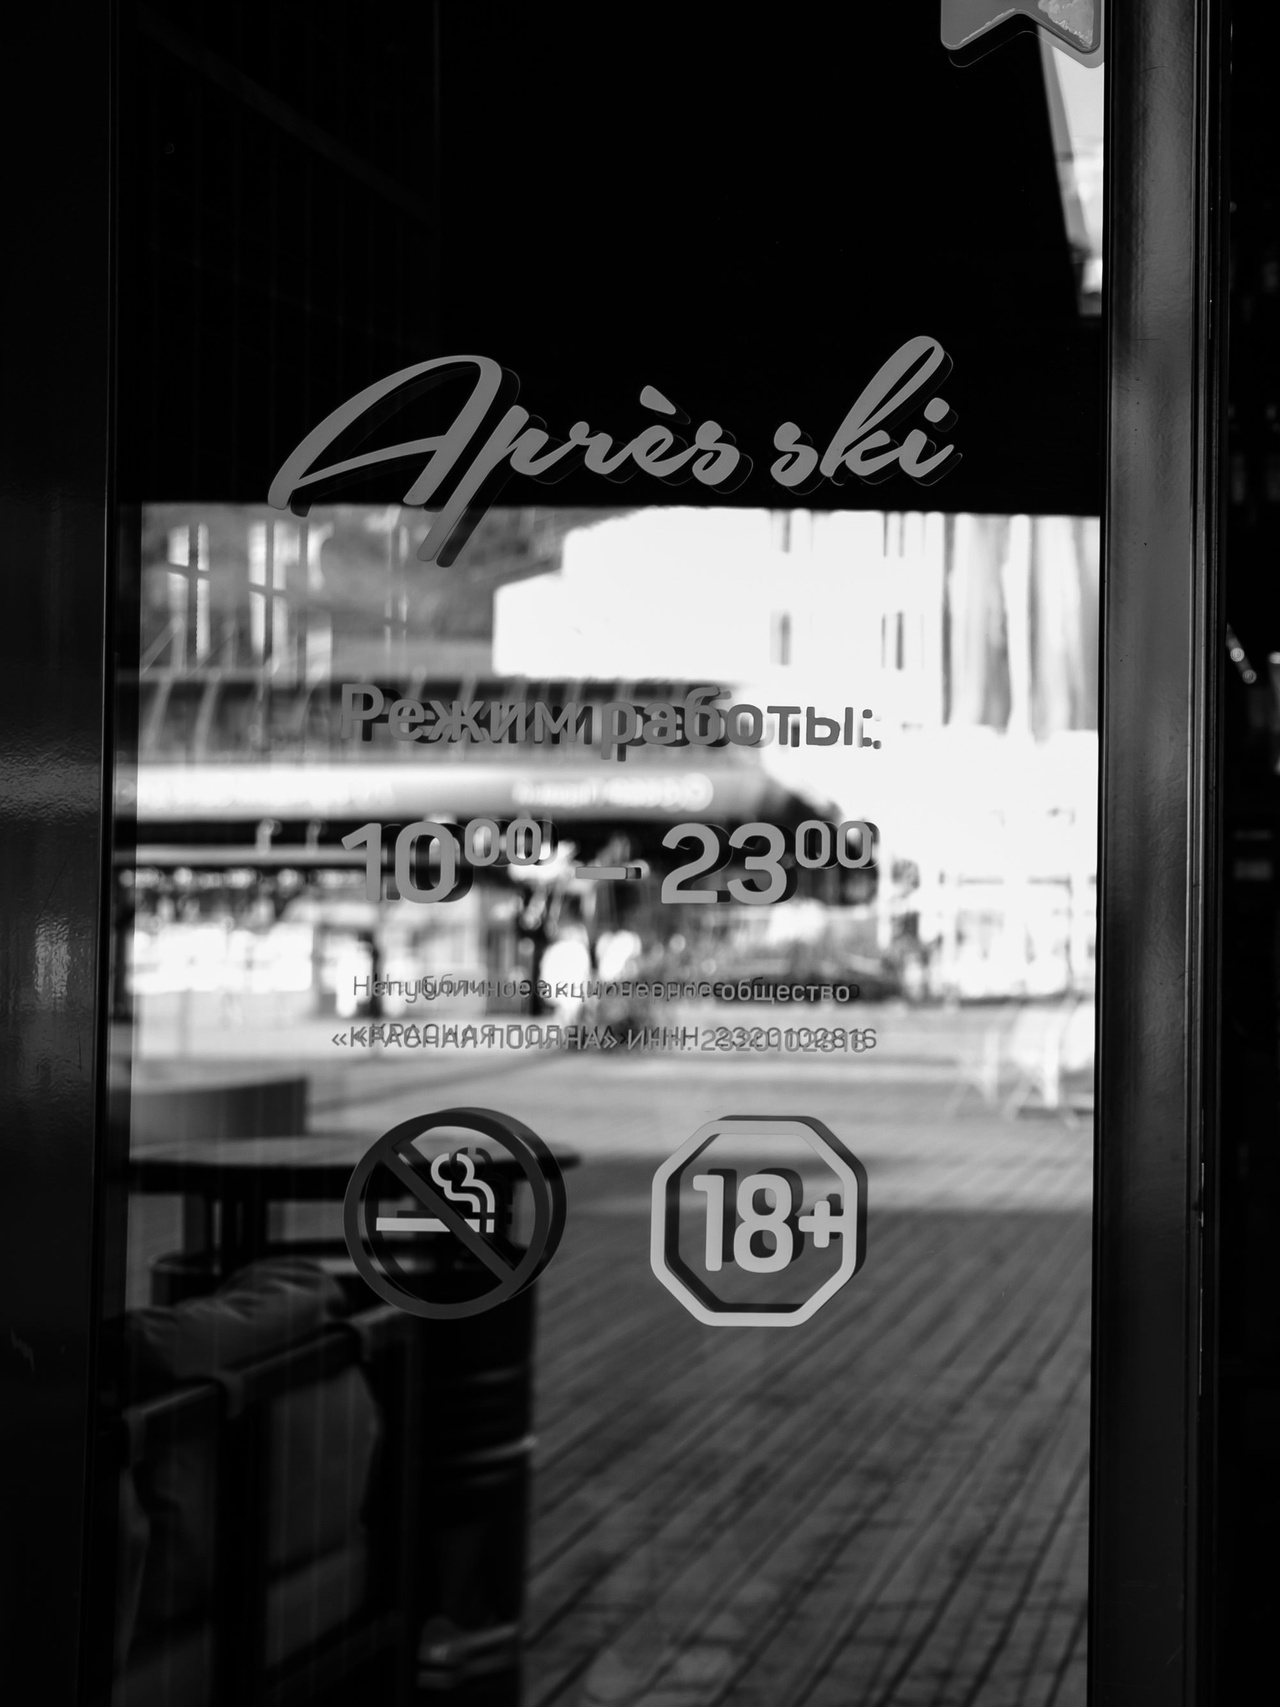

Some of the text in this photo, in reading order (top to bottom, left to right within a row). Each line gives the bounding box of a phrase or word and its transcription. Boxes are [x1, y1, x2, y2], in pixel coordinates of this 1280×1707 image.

[267, 335, 955, 563] Après ski
[340, 683, 873, 760] Режим работы:
[540, 981, 712, 1004] акционерное
[721, 978, 850, 1004] общество
[701, 1029, 868, 1053] 2320102816
[692, 1173, 845, 1274] 18+
